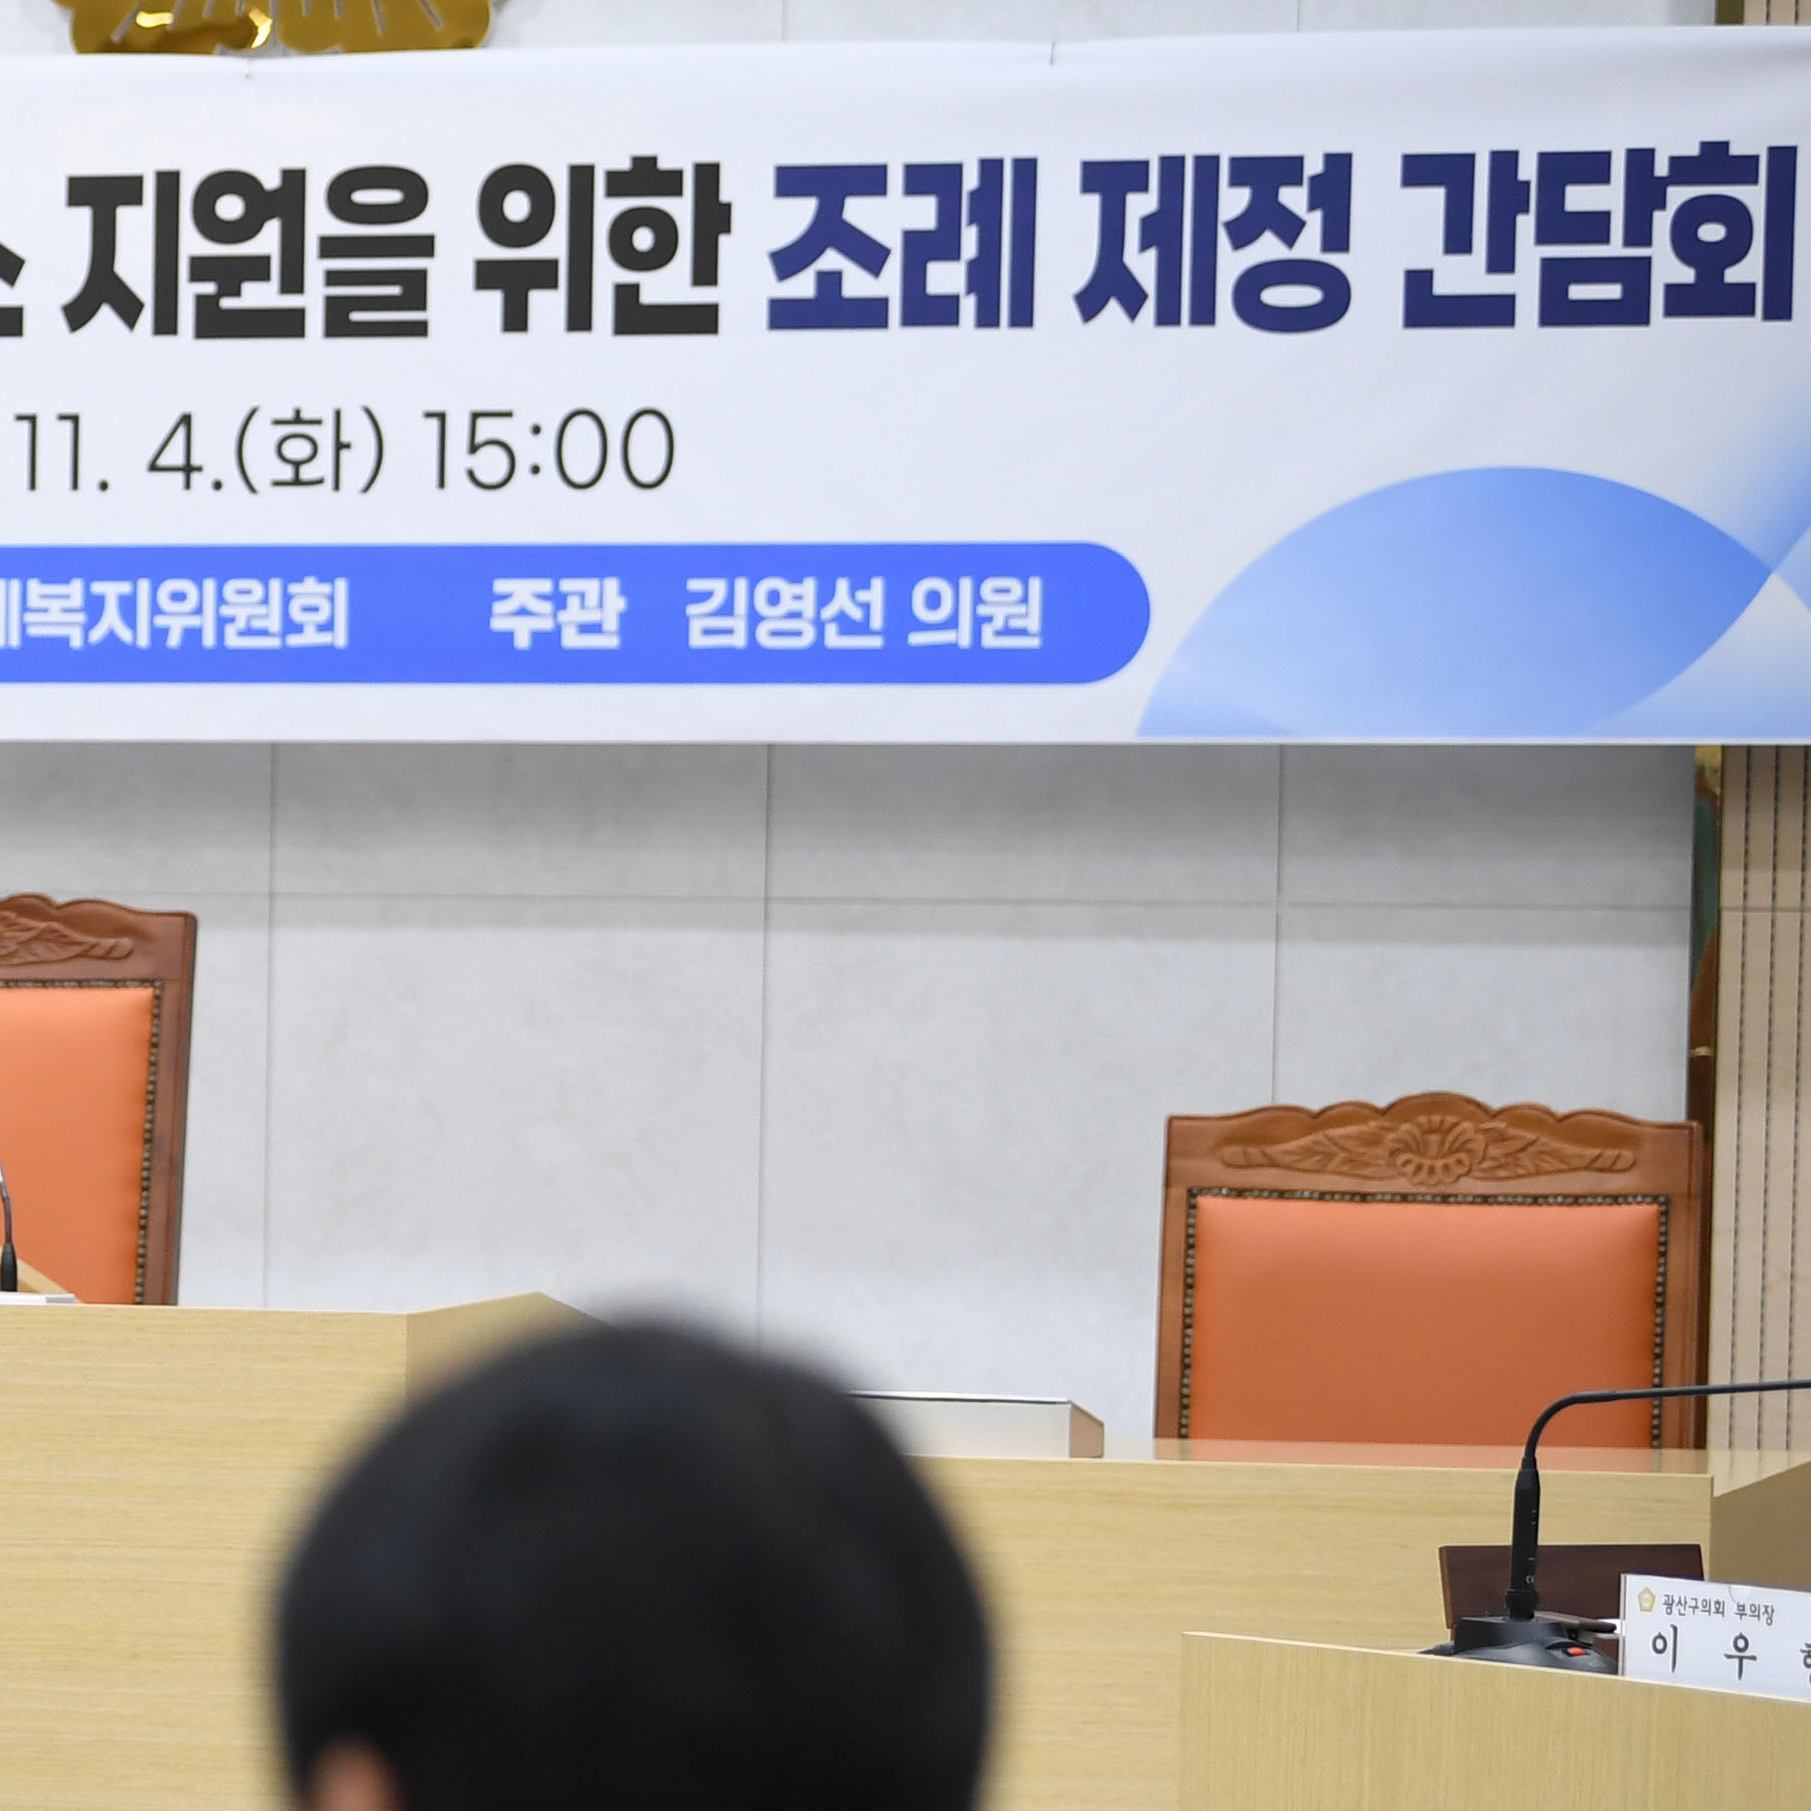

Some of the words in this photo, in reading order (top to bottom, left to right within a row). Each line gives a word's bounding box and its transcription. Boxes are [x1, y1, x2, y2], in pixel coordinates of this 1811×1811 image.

[63, 166, 434, 339] 지원을
[475, 156, 731, 335] 위한
[769, 158, 1037, 329] 조례
[1075, 153, 1352, 333] 제정
[1402, 141, 1797, 328] 간담회
[16, 414, 108, 491] 11.
[148, 407, 383, 493] 4.(화)
[424, 409, 674, 490] 15:00
[491, 578, 625, 648] 주관
[687, 578, 882, 647] 김영선
[909, 578, 1040, 646] 의원
[1664, 1595, 1724, 1616] 광산구의회
[1734, 1602, 1775, 1627] 부의장
